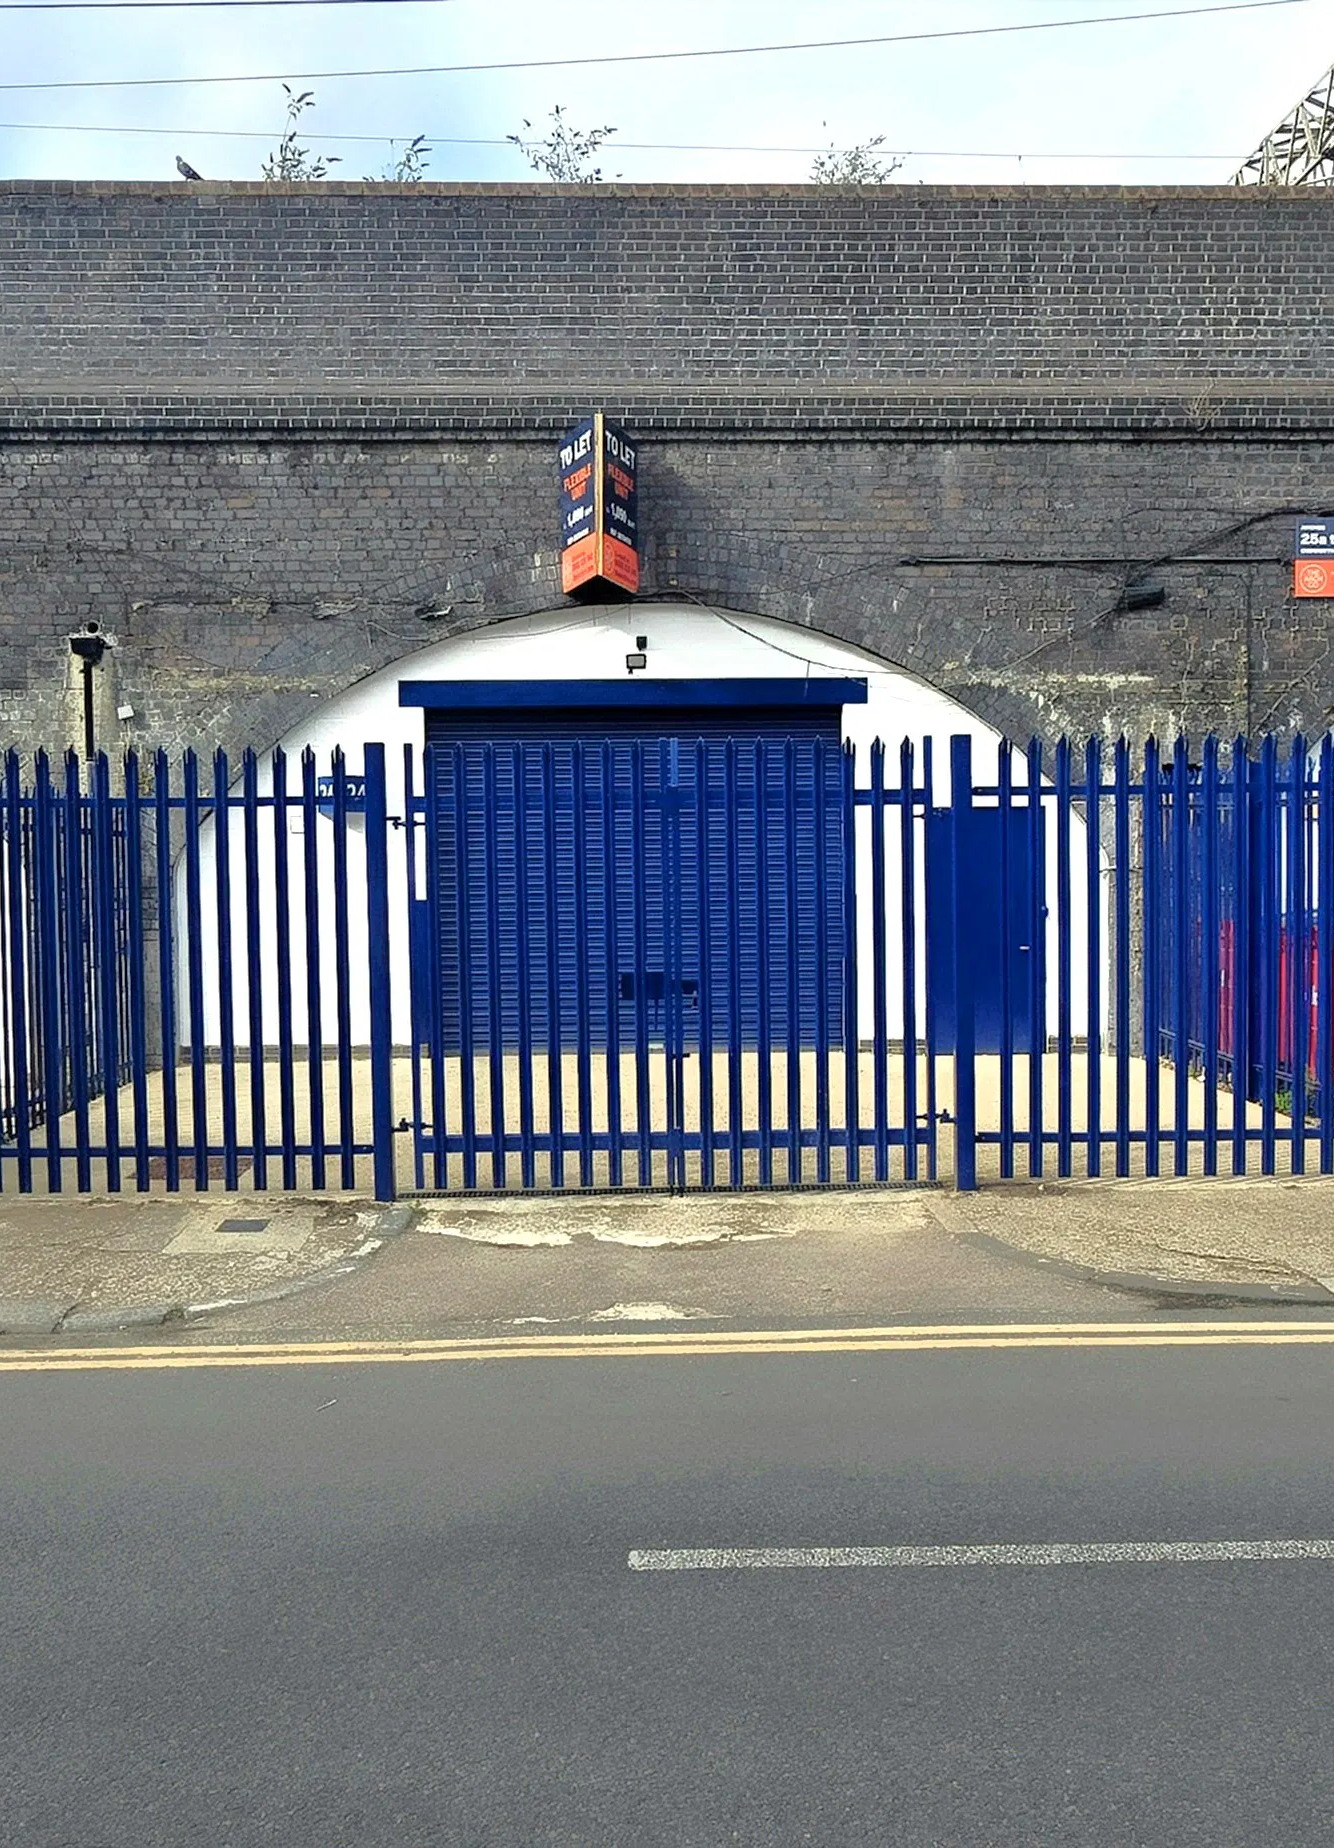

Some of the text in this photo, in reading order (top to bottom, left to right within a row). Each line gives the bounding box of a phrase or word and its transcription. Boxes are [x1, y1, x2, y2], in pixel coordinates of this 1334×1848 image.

[559, 429, 592, 469] TO LET
[605, 430, 635, 470] TO LET
[1300, 532, 1327, 545] 25a
